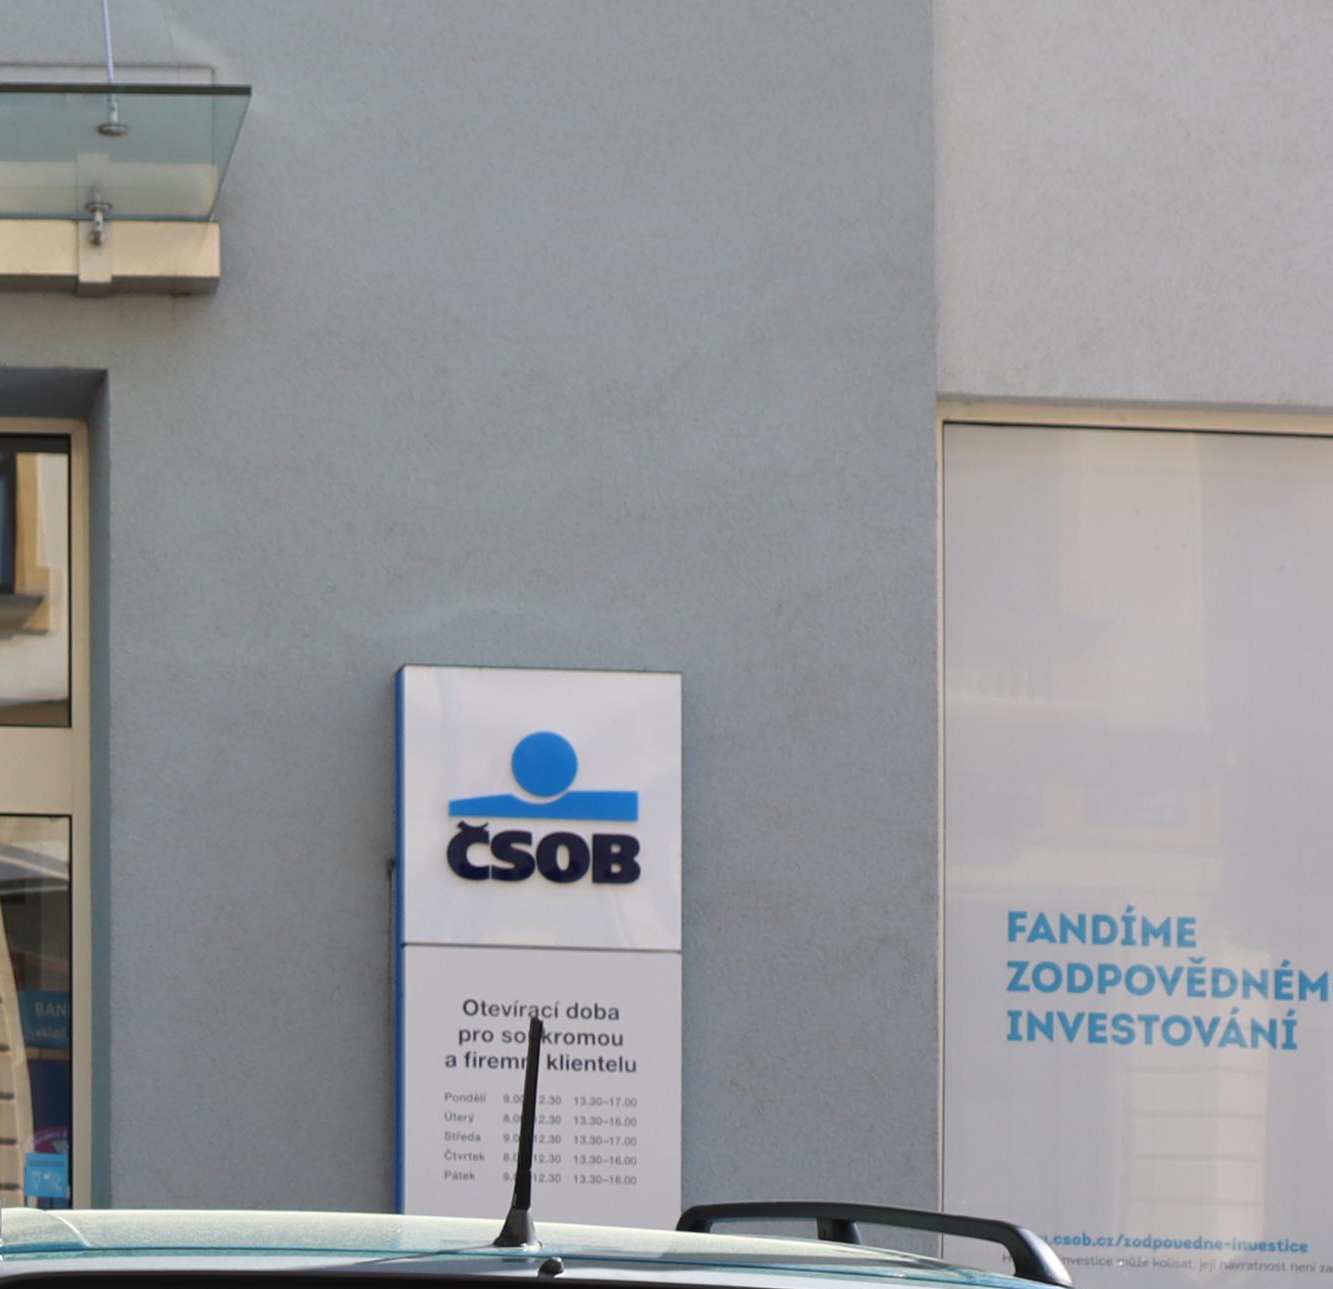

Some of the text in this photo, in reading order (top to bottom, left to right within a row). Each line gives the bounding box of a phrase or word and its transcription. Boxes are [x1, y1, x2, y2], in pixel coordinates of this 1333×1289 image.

[446, 820, 641, 884] ČSOB
[1007, 905, 1197, 948] FANDÍME
[1007, 957, 1330, 1002] ZODPOVĚDNÉM
[462, 999, 620, 1020] Otevírací doba
[459, 1028, 624, 1047] pro sokromou
[1007, 1007, 1298, 1050] INVESTOVÁNÍ
[445, 1051, 637, 1073] a firemn klientelu
[444, 1112, 475, 1124] Úterý
[444, 1131, 481, 1142] Středa
[1060, 1255, 1114, 1268] nvestice
